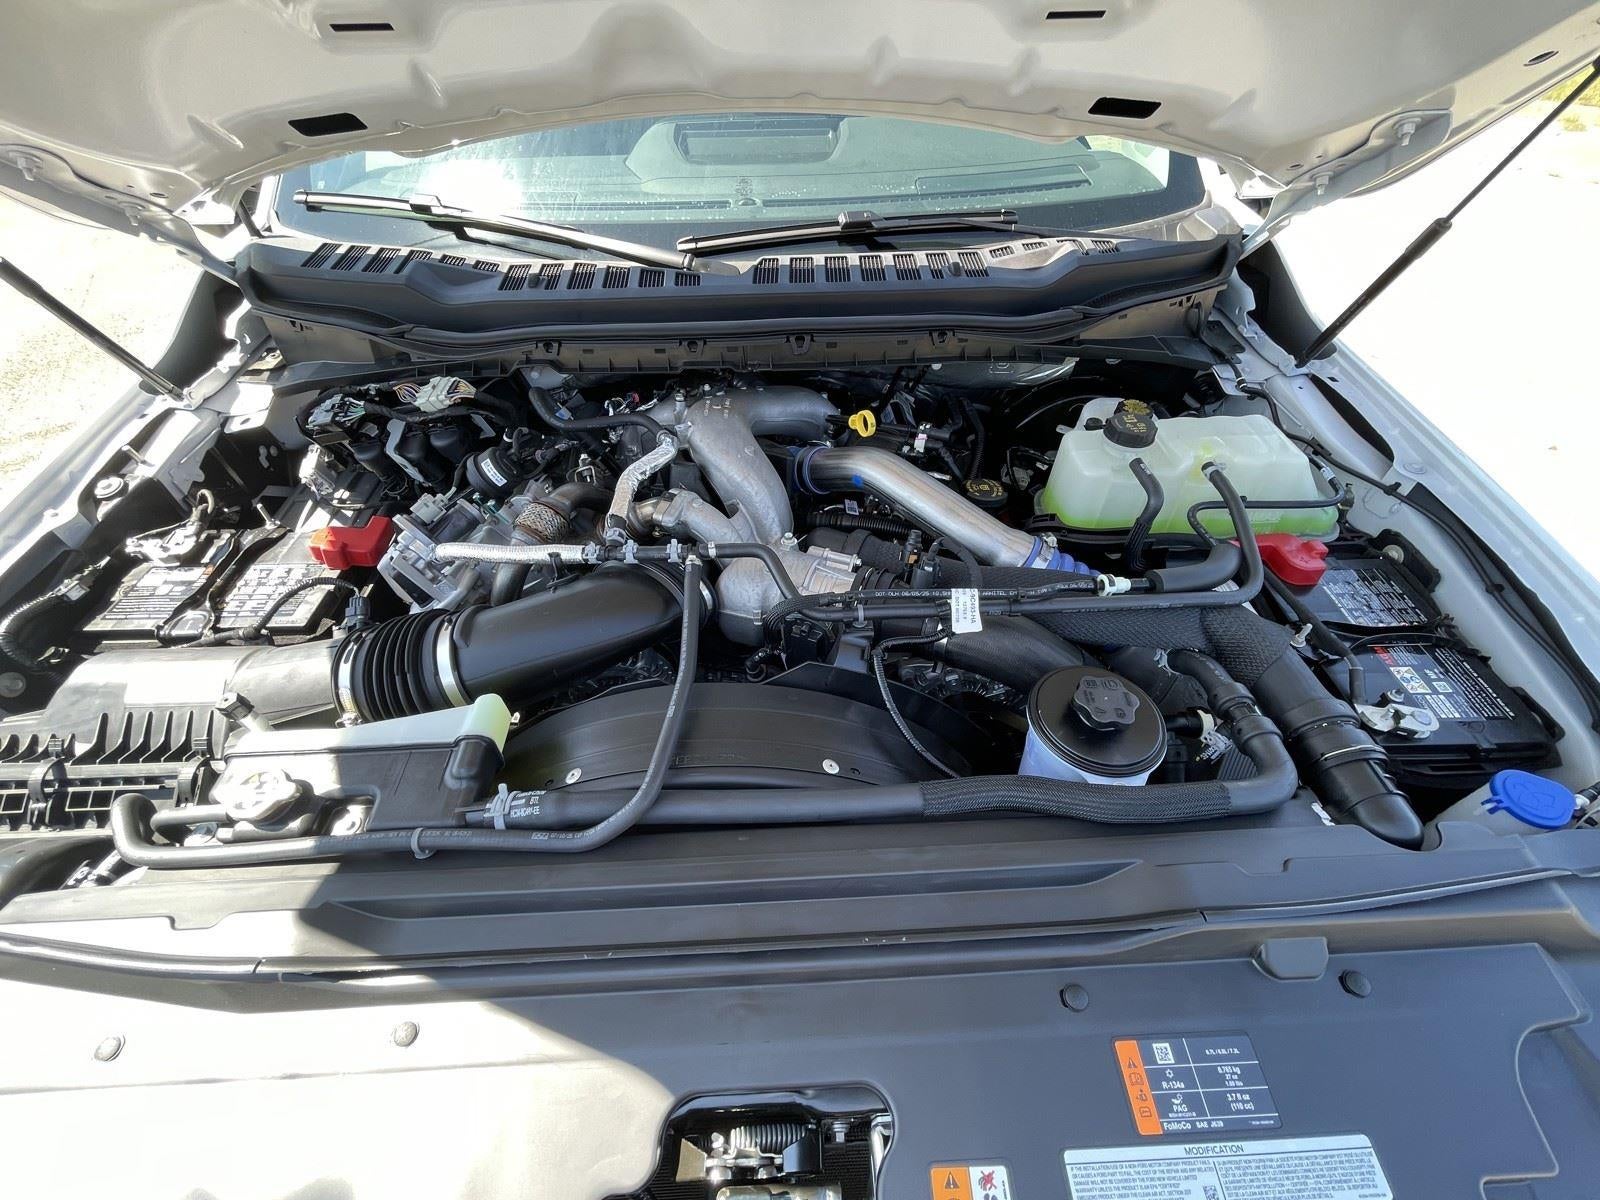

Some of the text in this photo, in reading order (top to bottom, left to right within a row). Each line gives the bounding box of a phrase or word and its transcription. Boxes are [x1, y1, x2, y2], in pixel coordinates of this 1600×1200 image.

[1162, 1080, 1185, 1090] R-134a
[1172, 1104, 1188, 1112] PAG
[1162, 1121, 1192, 1130] FoMoCo
[1184, 1144, 1245, 1156] MODIFICATION
